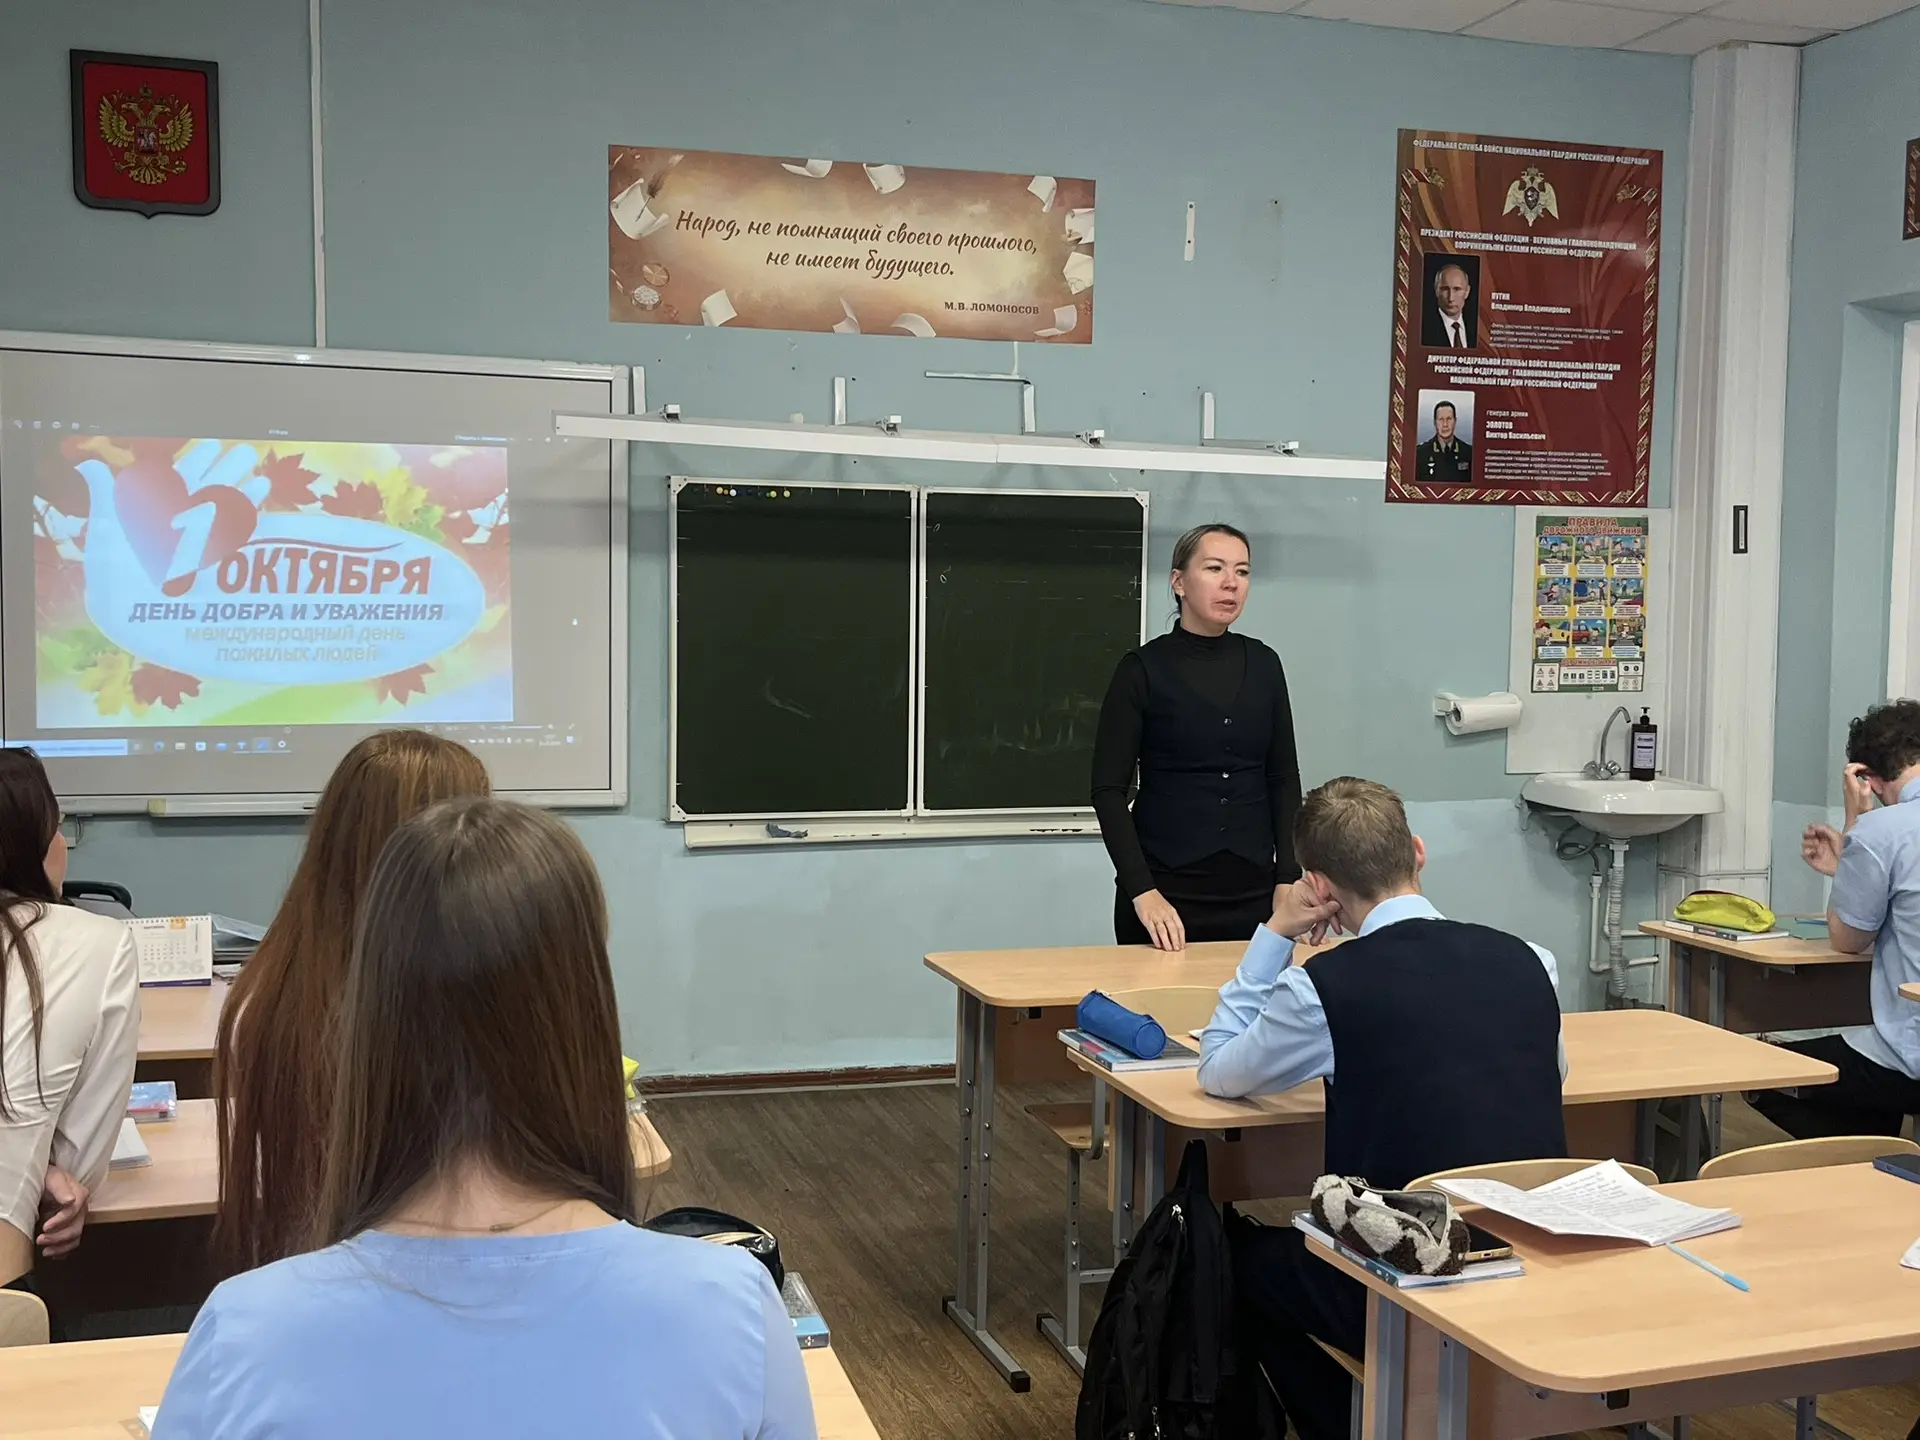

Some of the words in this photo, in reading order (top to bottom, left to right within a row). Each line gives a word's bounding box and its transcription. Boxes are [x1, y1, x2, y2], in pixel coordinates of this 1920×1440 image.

[1413, 139, 1457, 149] ФЕДЕРАЛЬНАЯ
[1458, 142, 1483, 152] СЛУЖБА
[1484, 144, 1503, 153] ВОЙСК
[1504, 146, 1550, 157] НАЦИОНАЛЬНОЙ
[1551, 150, 1577, 160] ГВАРДИИ
[1578, 153, 1614, 163] РОССИЙСКОЙ
[1615, 156, 1649, 165] ФЕДЕРАЦИИ
[676, 210, 741, 241] Народ,
[747, 221, 772, 236] не
[776, 222, 883, 244] помнящий
[887, 222, 943, 246] своего
[947, 232, 1038, 254] прошлого,
[1420, 228, 1454, 238] ПРЕЗИДЕНТ
[1455, 231, 1493, 241] РОССИЙСКОЙ
[1494, 234, 1529, 243] ФЕДЕРАЦИИ
[1533, 236, 1567, 246] ВЕРХОВНЫЙ
[1505, 245, 1529, 253] СИЛАМИ
[1530, 246, 1568, 256] РОССИЙСКОЙ
[1568, 249, 1603, 259] ФЕДЕРАЦИИ
[766, 251, 790, 266] не
[795, 253, 859, 270] имеет
[865, 249, 954, 280] будущего.
[1491, 292, 1510, 301] ПУТИН
[1491, 302, 1523, 312] Владимир
[1524, 304, 1570, 314] Владимирович
[1427, 355, 1457, 364] ДИРЕКТОР
[1458, 356, 1500, 366] ФЕДЕРАЛЬНОЙ
[1501, 358, 1527, 366] СЛУЖБЫ
[1529, 359, 1547, 368] ВОЙСК
[1548, 360, 1593, 370] НАЦИОНАЛЬНОЙ
[1594, 363, 1621, 372] ГВАРДИИ
[1434, 365, 1473, 374] РОССИЙСКОЙ
[1474, 367, 1509, 376] ФЕДЕРАЦИИ
[1512, 369, 1581, 379] ГЛАВНОКОМАНДУЮЩИЙ
[1582, 371, 1613, 381] ВОЙСКАМИ
[1450, 376, 1496, 385] НАЦИОНАЛЬНОЙ
[1497, 378, 1523, 387] ГВАРДИИ
[1524, 379, 1562, 388] РОССИЙСКОЙ
[1562, 381, 1597, 390] ФЕДЕРАЦИИ
[1486, 410, 1509, 418] генерал
[1486, 421, 1513, 429] ЗОЛОТОВ
[1485, 431, 1508, 440] Виктор
[1508, 431, 1546, 440] Васильевич
[1568, 517, 1618, 526] ПРАВИЛА
[1543, 525, 1595, 535] ДОРОЖНОГО
[1596, 527, 1643, 535] ДВИЖЕНИЯ
[162, 501, 216, 595] 1
[217, 547, 431, 594] ОКТЯБРЯ
[128, 603, 197, 623] ДЕНЬ
[200, 603, 284, 623] ДОБРА
[290, 603, 307, 621] И
[313, 604, 444, 621] УВАЖЕНИЯ
